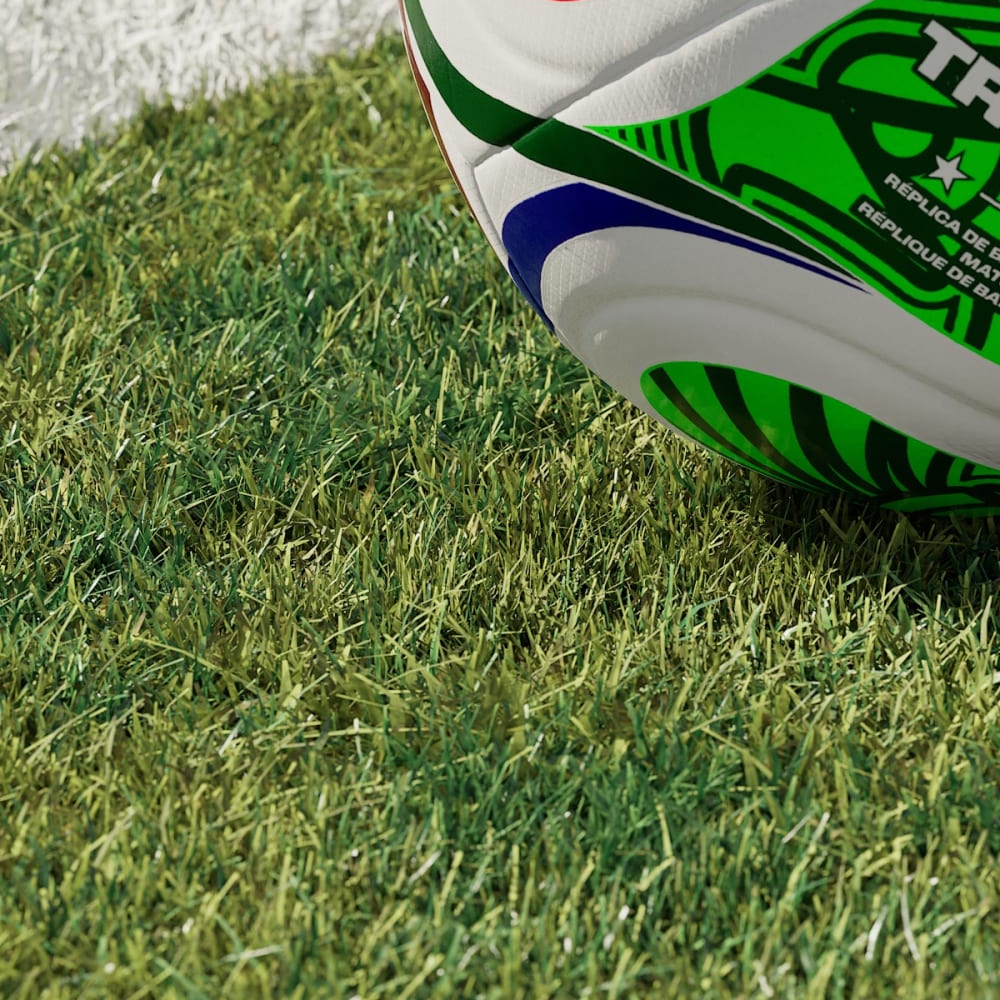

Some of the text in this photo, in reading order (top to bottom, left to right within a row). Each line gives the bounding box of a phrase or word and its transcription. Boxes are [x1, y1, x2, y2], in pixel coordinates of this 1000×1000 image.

[884, 173, 961, 234] RÉPLICA
[962, 229, 990, 252] DE
[946, 265, 975, 288] DE
